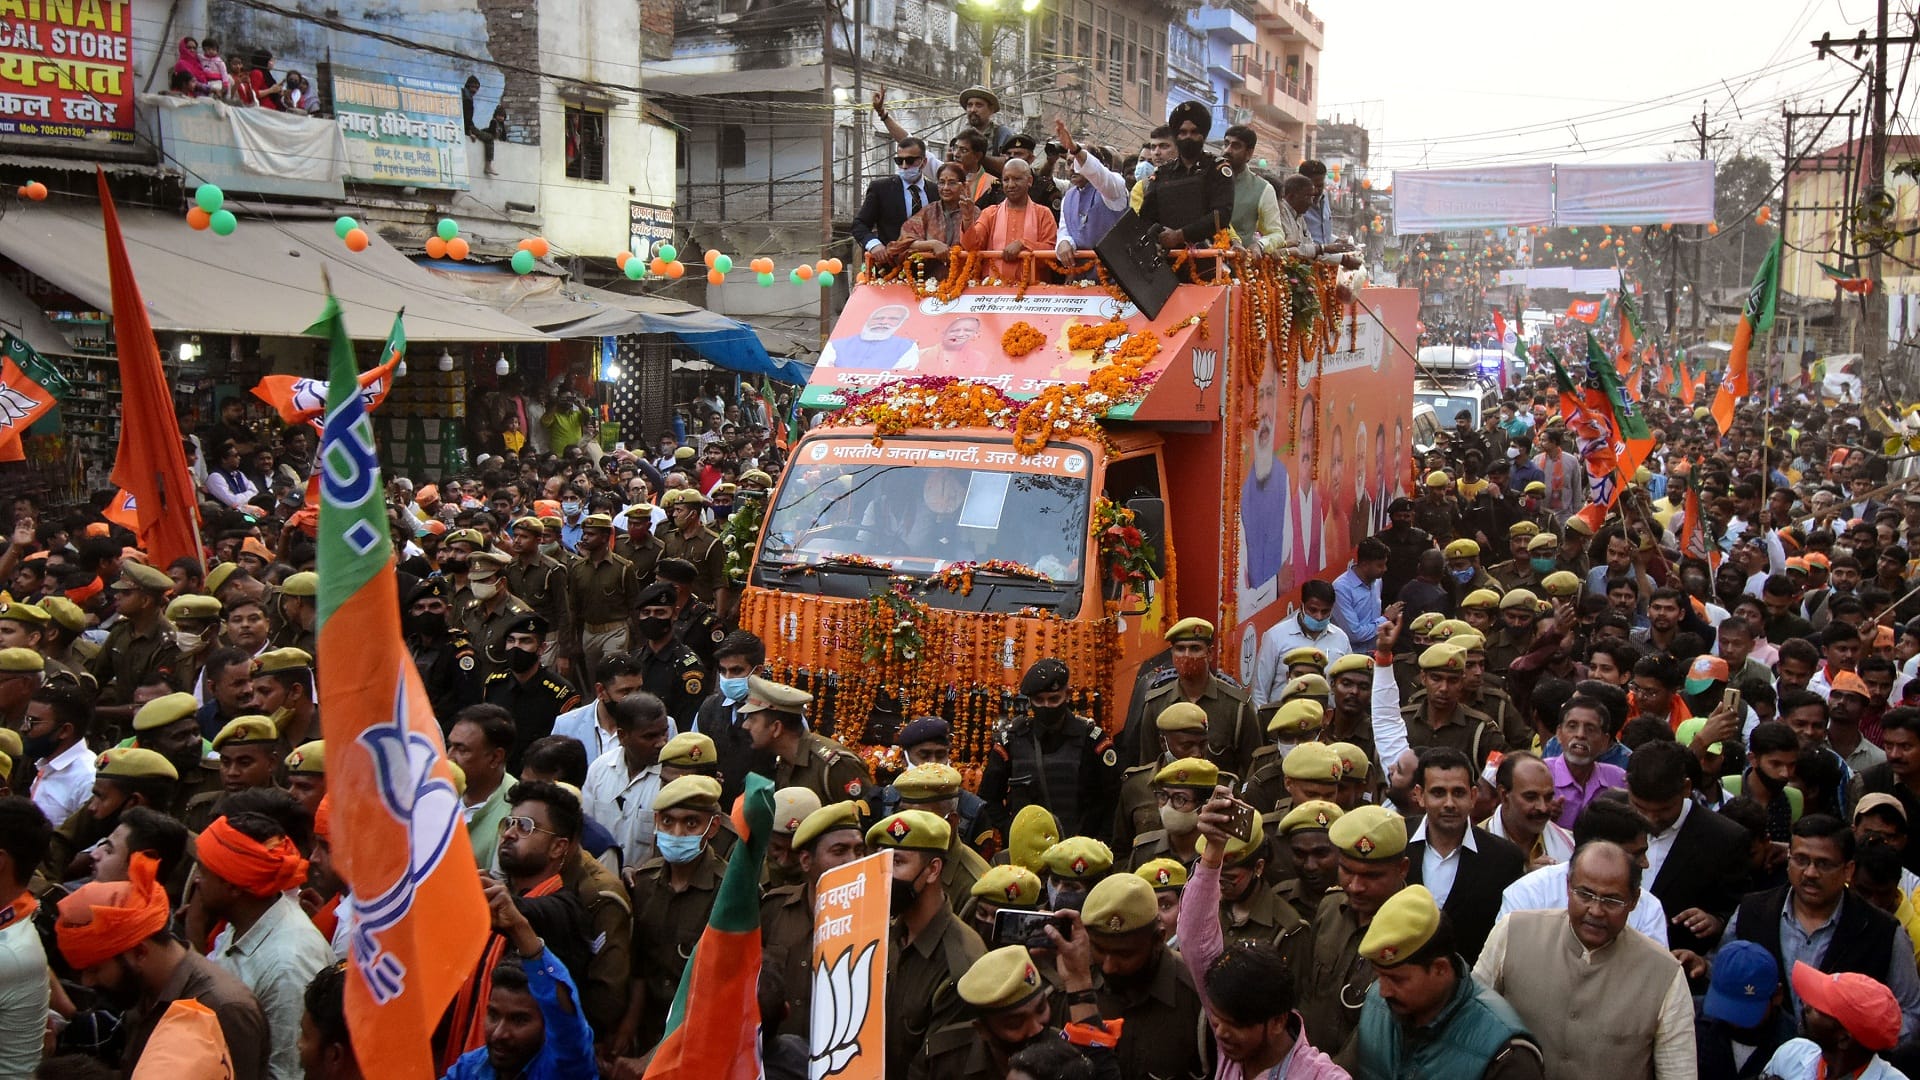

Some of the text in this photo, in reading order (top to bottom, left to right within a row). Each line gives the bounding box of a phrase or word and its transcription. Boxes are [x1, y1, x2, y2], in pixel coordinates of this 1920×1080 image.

[51, 28, 127, 61] STORE
[61, 94, 118, 123] स्टोर
[337, 110, 380, 140] लालू
[1024, 305, 1052, 313] भाजपा
[1053, 306, 1084, 314] सरकार
[1053, 297, 1089, 305] असरदार
[832, 443, 1059, 469] भारतीय जनता पार्टी, उत्तर प्रदेश
[828, 873, 866, 910] वसूली
